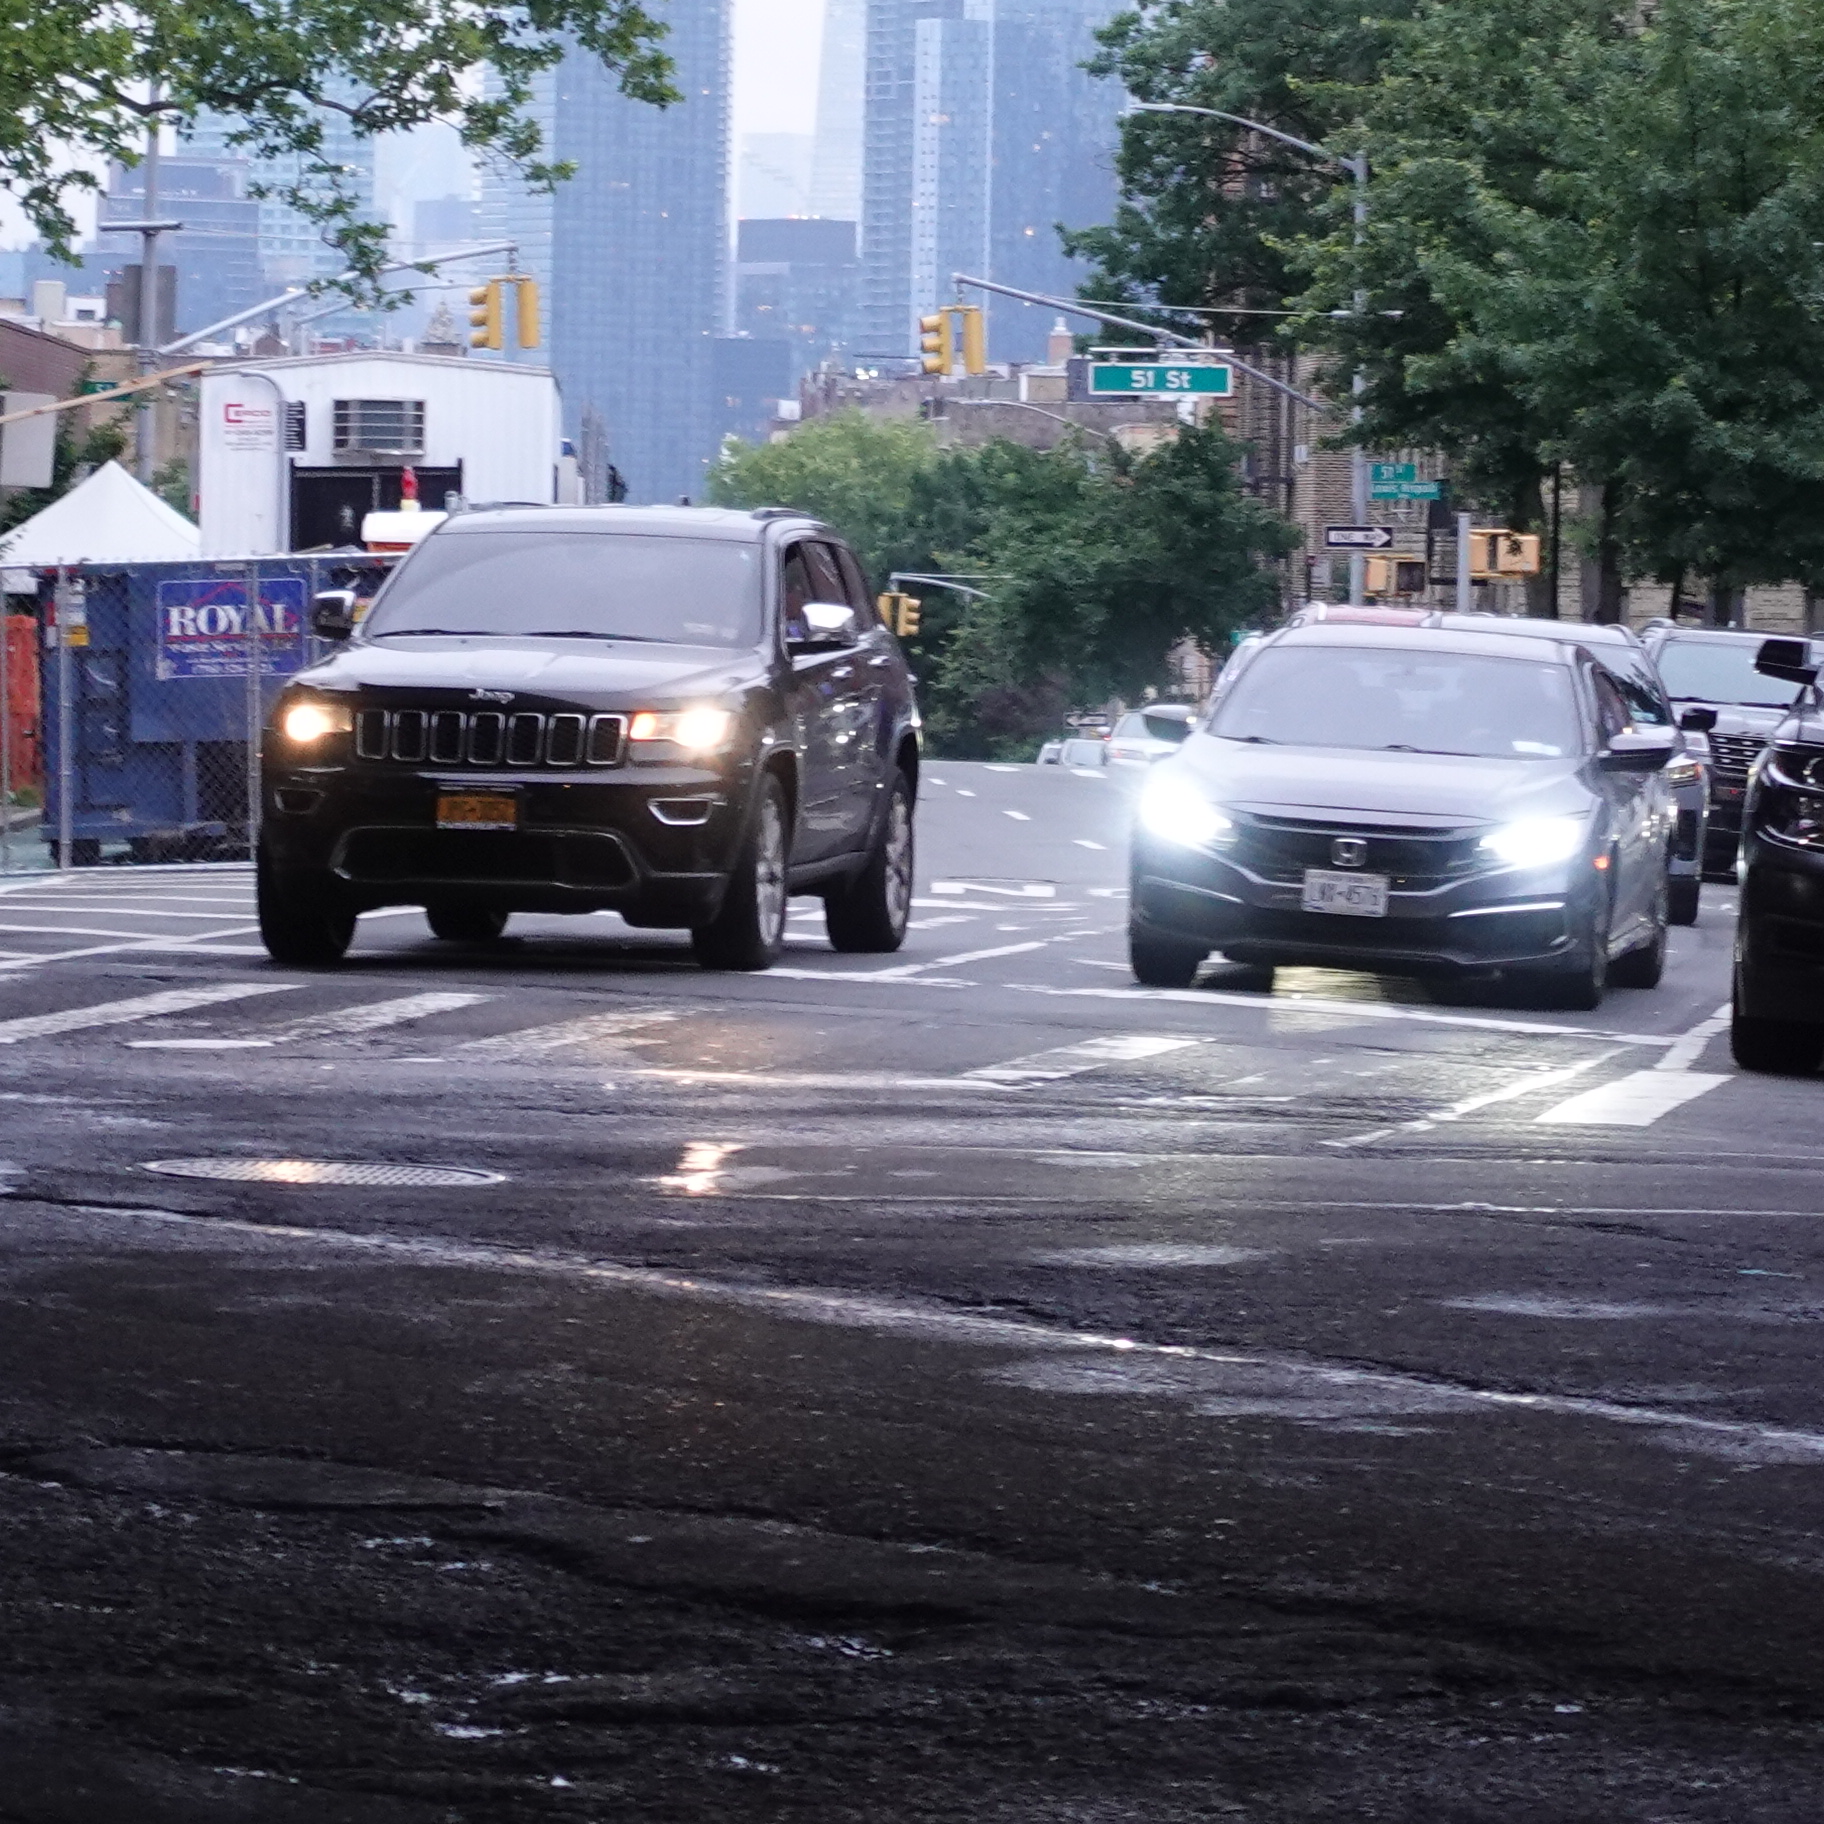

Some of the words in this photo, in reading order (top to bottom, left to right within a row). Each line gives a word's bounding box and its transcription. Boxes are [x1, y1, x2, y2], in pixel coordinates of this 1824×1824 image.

[1131, 370, 1155, 388] 51
[1165, 370, 1192, 389] St
[166, 603, 300, 637] ROYAL
